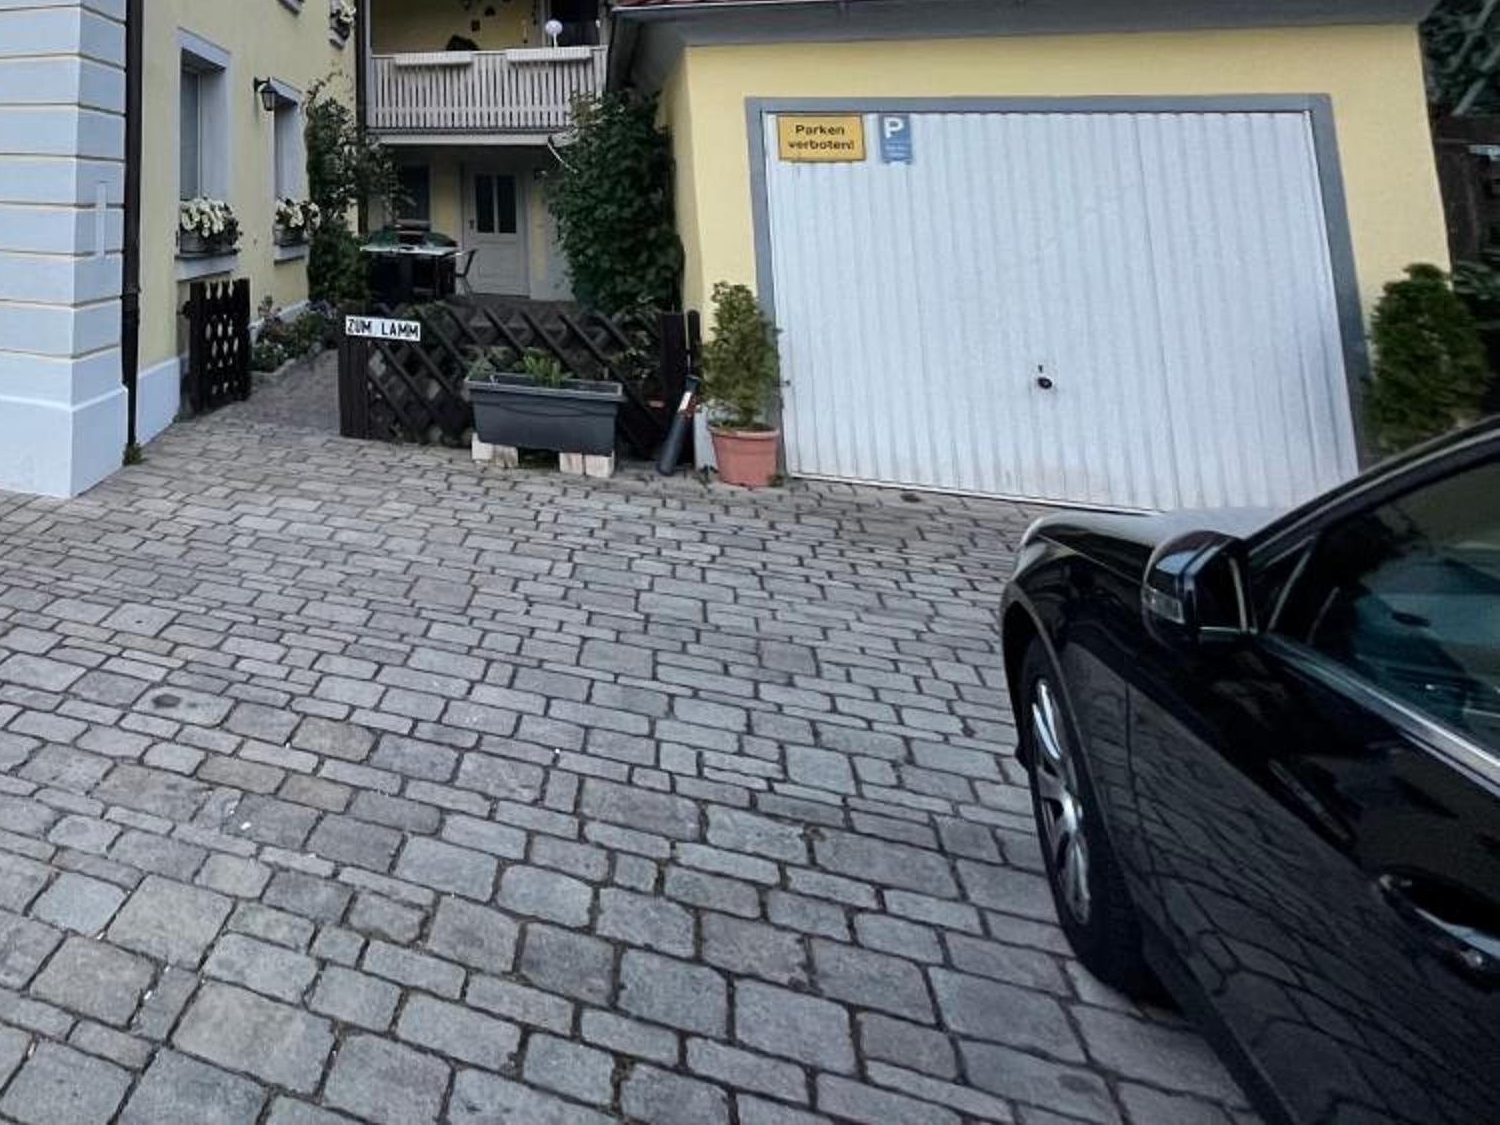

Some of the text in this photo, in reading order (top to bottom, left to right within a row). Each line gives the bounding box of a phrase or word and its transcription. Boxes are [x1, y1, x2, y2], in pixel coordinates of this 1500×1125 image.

[795, 124, 845, 136] Parken
[883, 118, 904, 139] P
[788, 140, 855, 150] verboten!
[347, 318, 419, 339] ZUM LAMM
